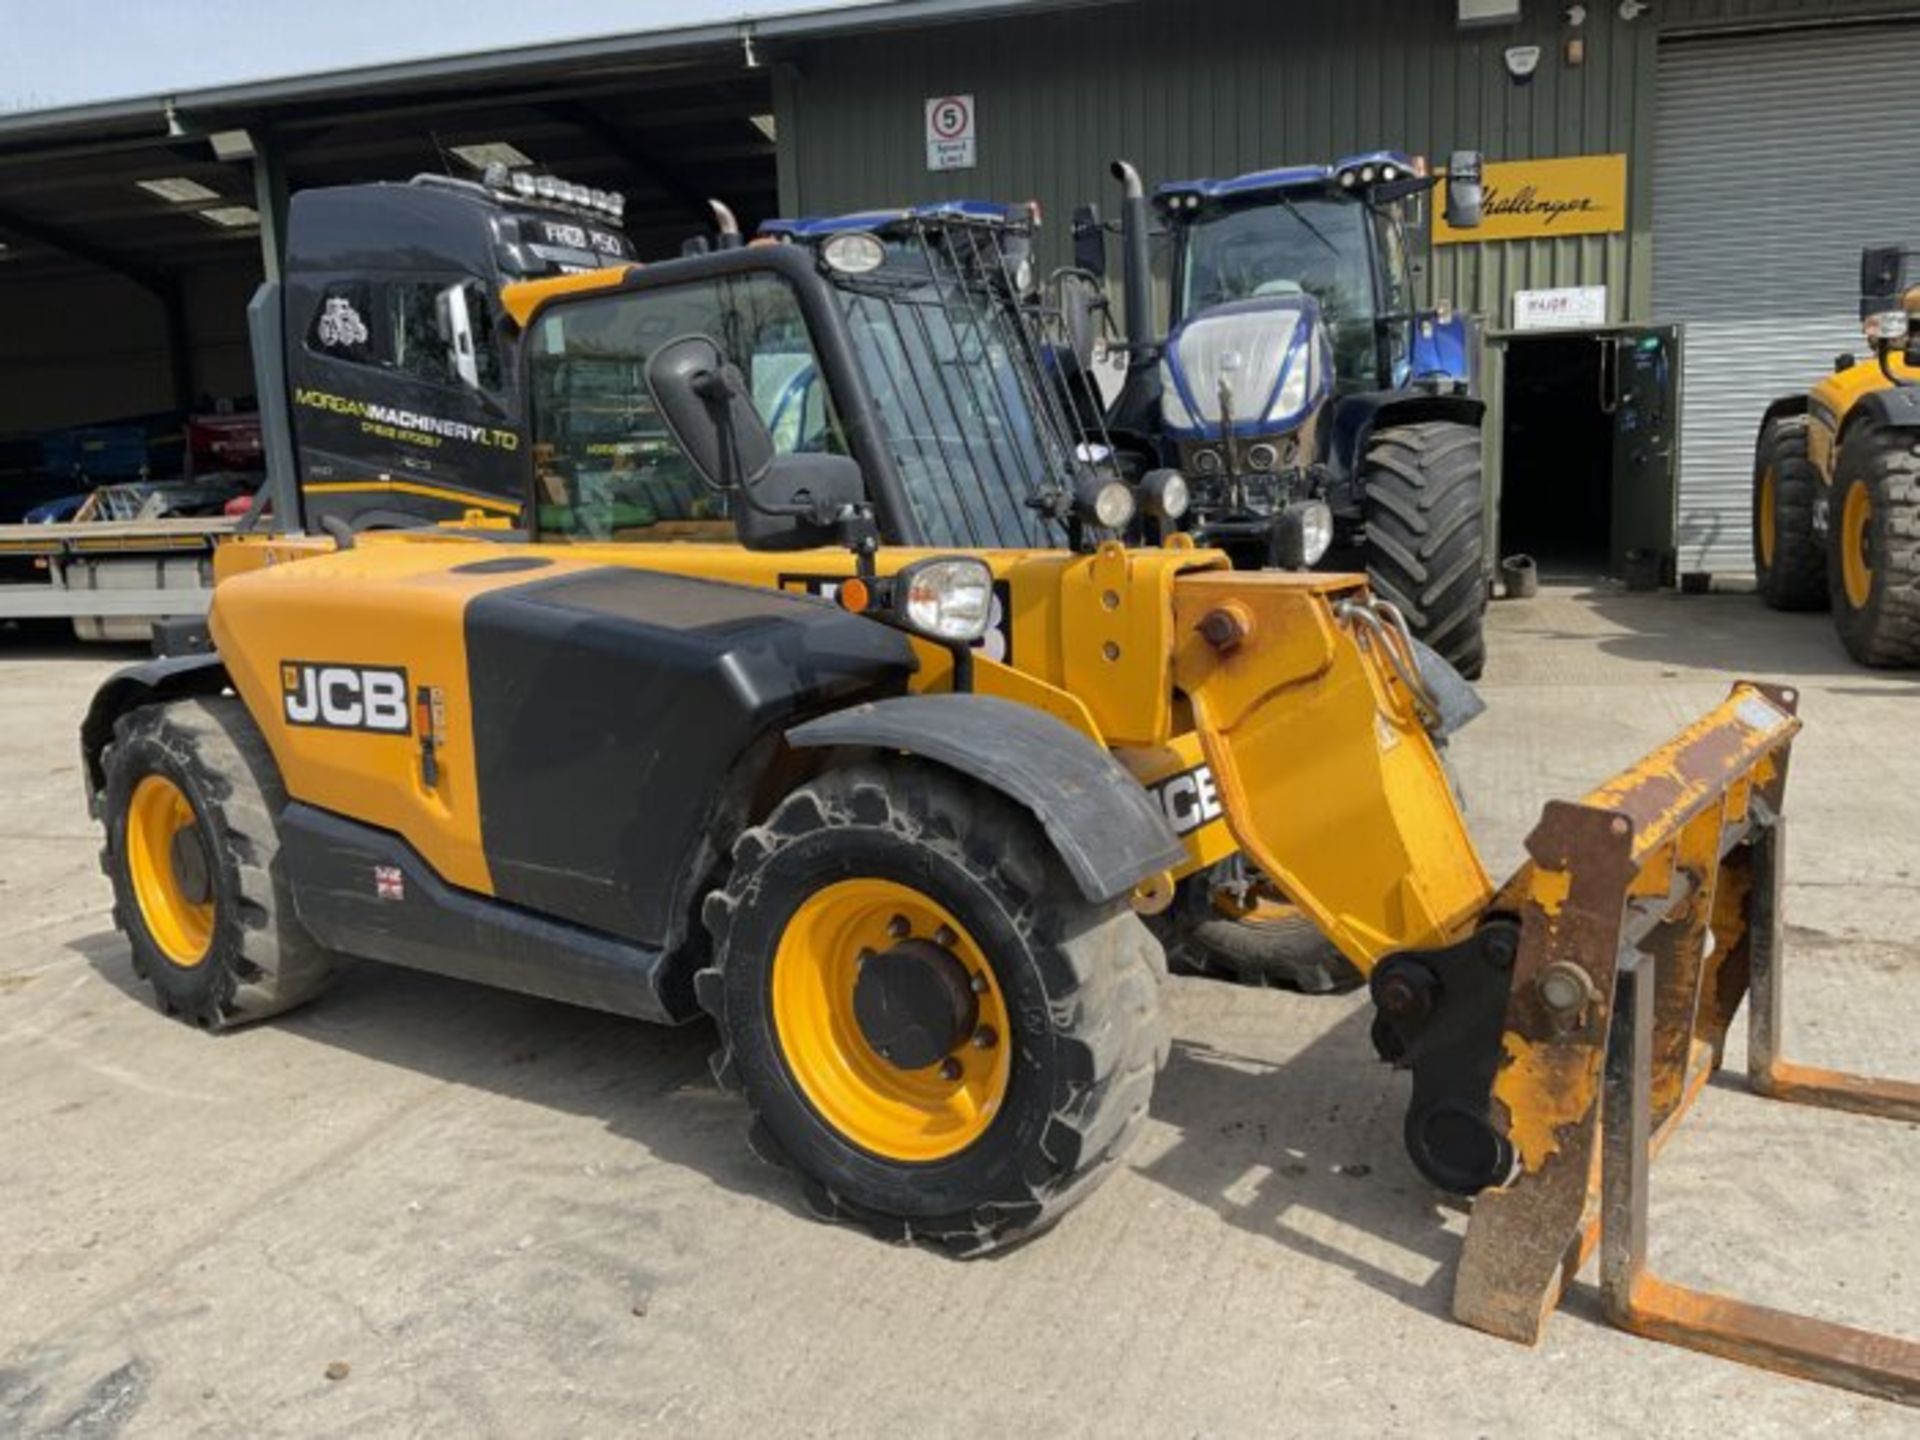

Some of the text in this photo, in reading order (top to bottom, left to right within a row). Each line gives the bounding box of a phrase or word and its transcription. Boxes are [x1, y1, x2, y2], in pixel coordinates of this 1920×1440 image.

[943, 109, 956, 129] 5
[1480, 185, 1594, 226] hallenger
[285, 666, 409, 730] JCB
